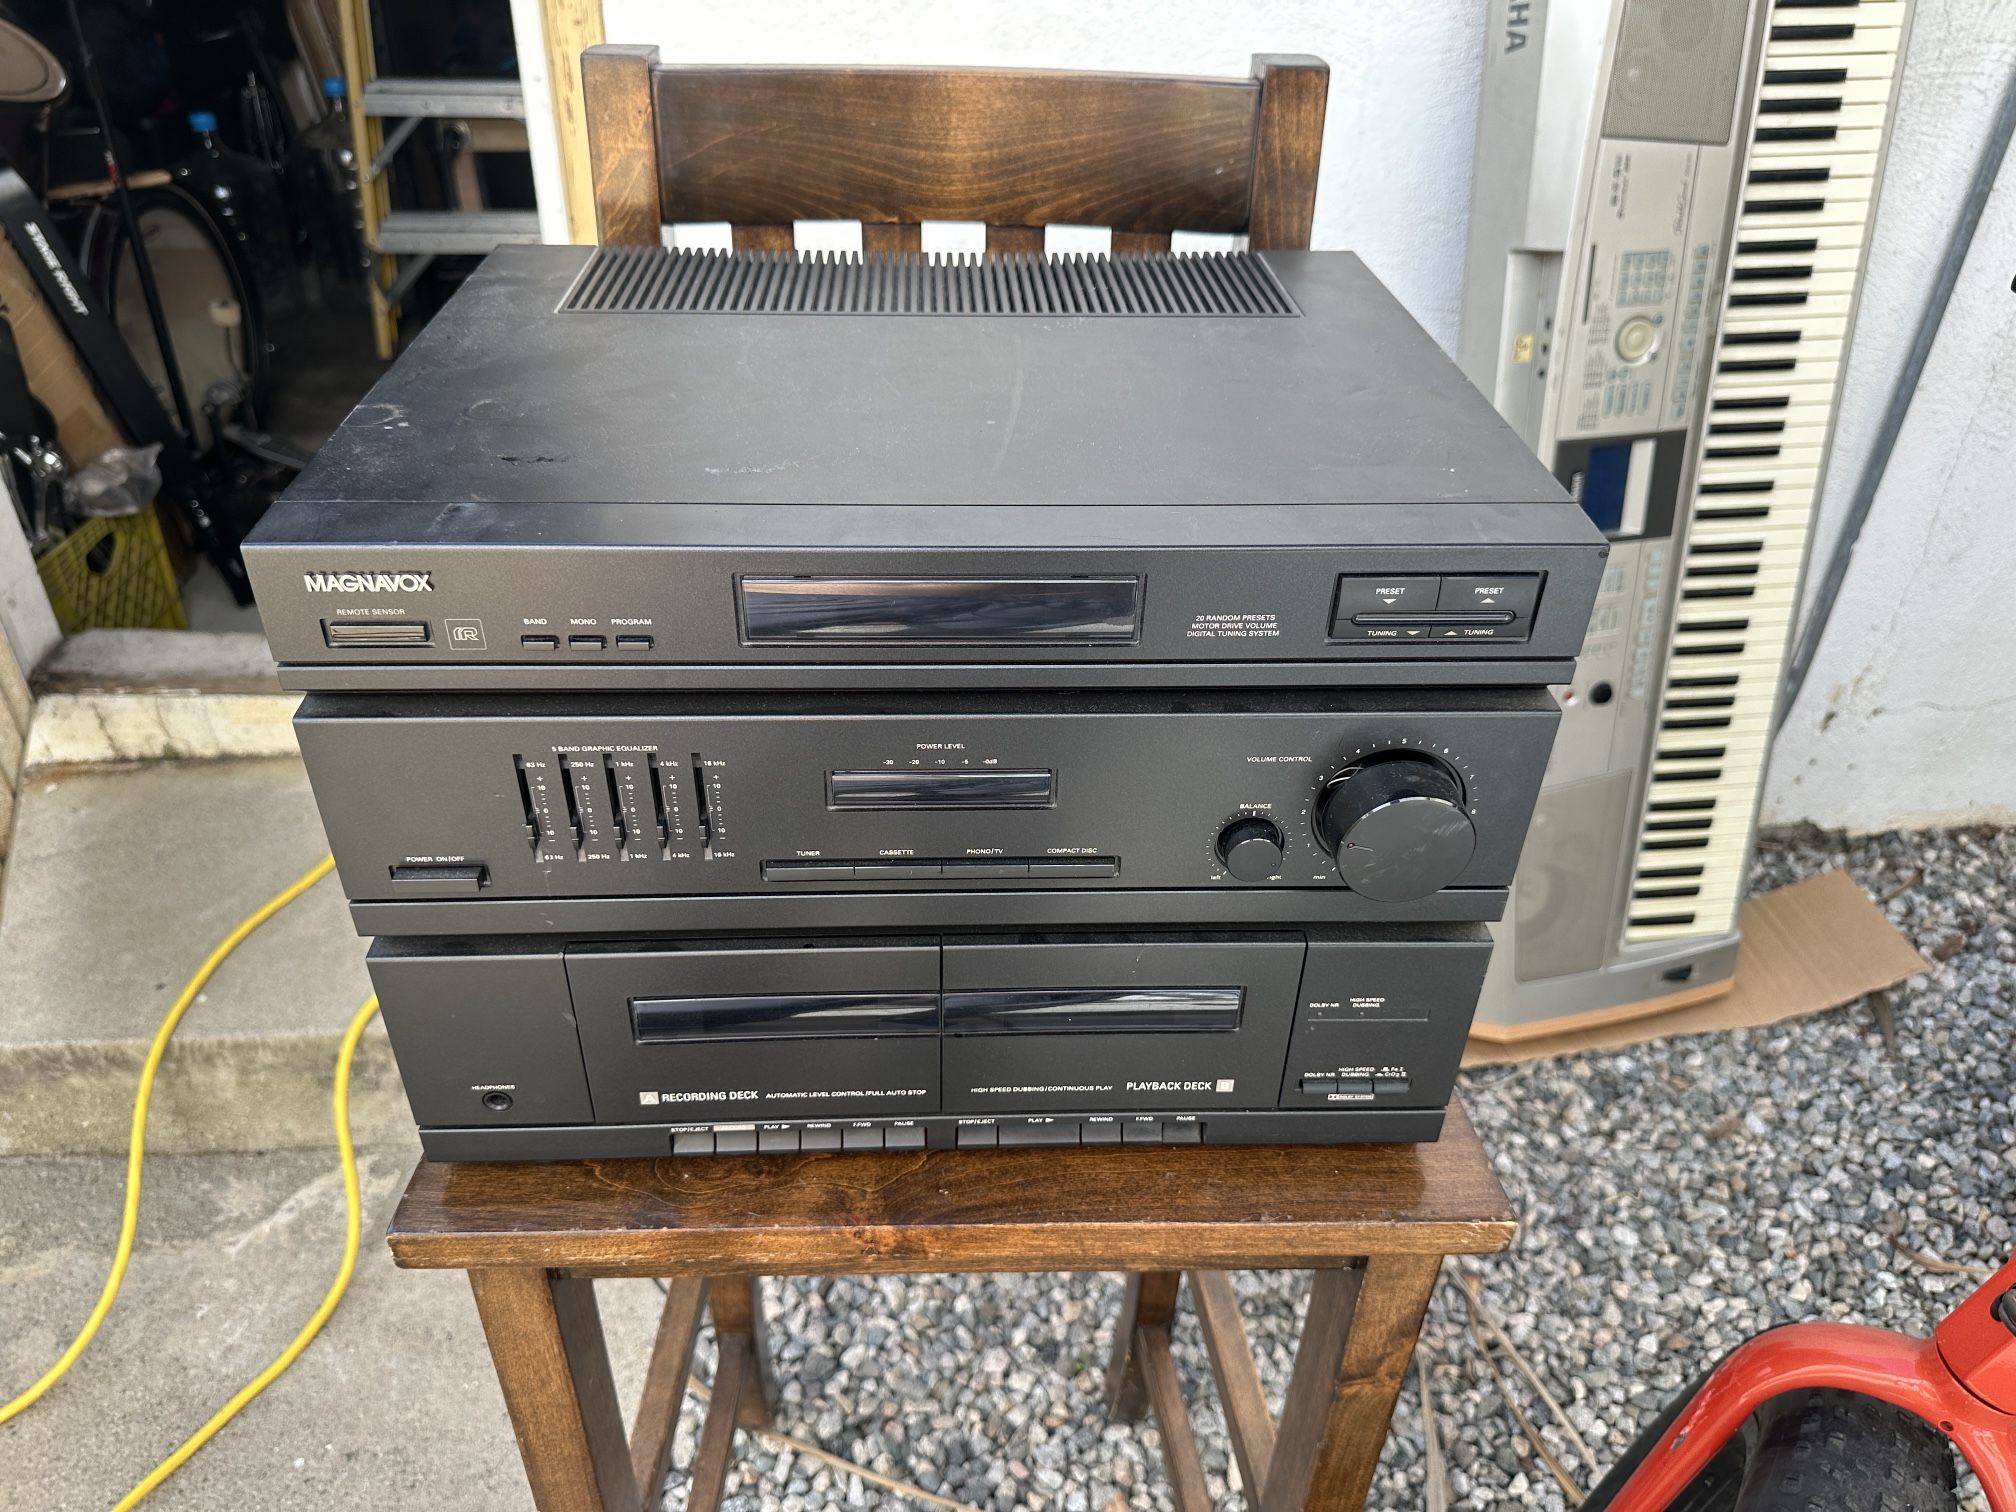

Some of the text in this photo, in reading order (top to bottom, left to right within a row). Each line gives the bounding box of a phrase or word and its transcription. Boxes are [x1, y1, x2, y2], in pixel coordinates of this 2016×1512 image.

[25, 221, 89, 316] STAGE RIGHT
[303, 572, 434, 592] MAGNAVOX
[1475, 587, 1504, 595] PRESET
[336, 608, 405, 616] REMOTE SENSOR
[1126, 1081, 1182, 1091] PLAYBACK
[1183, 1081, 1212, 1090] DECK
[661, 1092, 727, 1102] RECORDING
[729, 1091, 759, 1099] DECK
